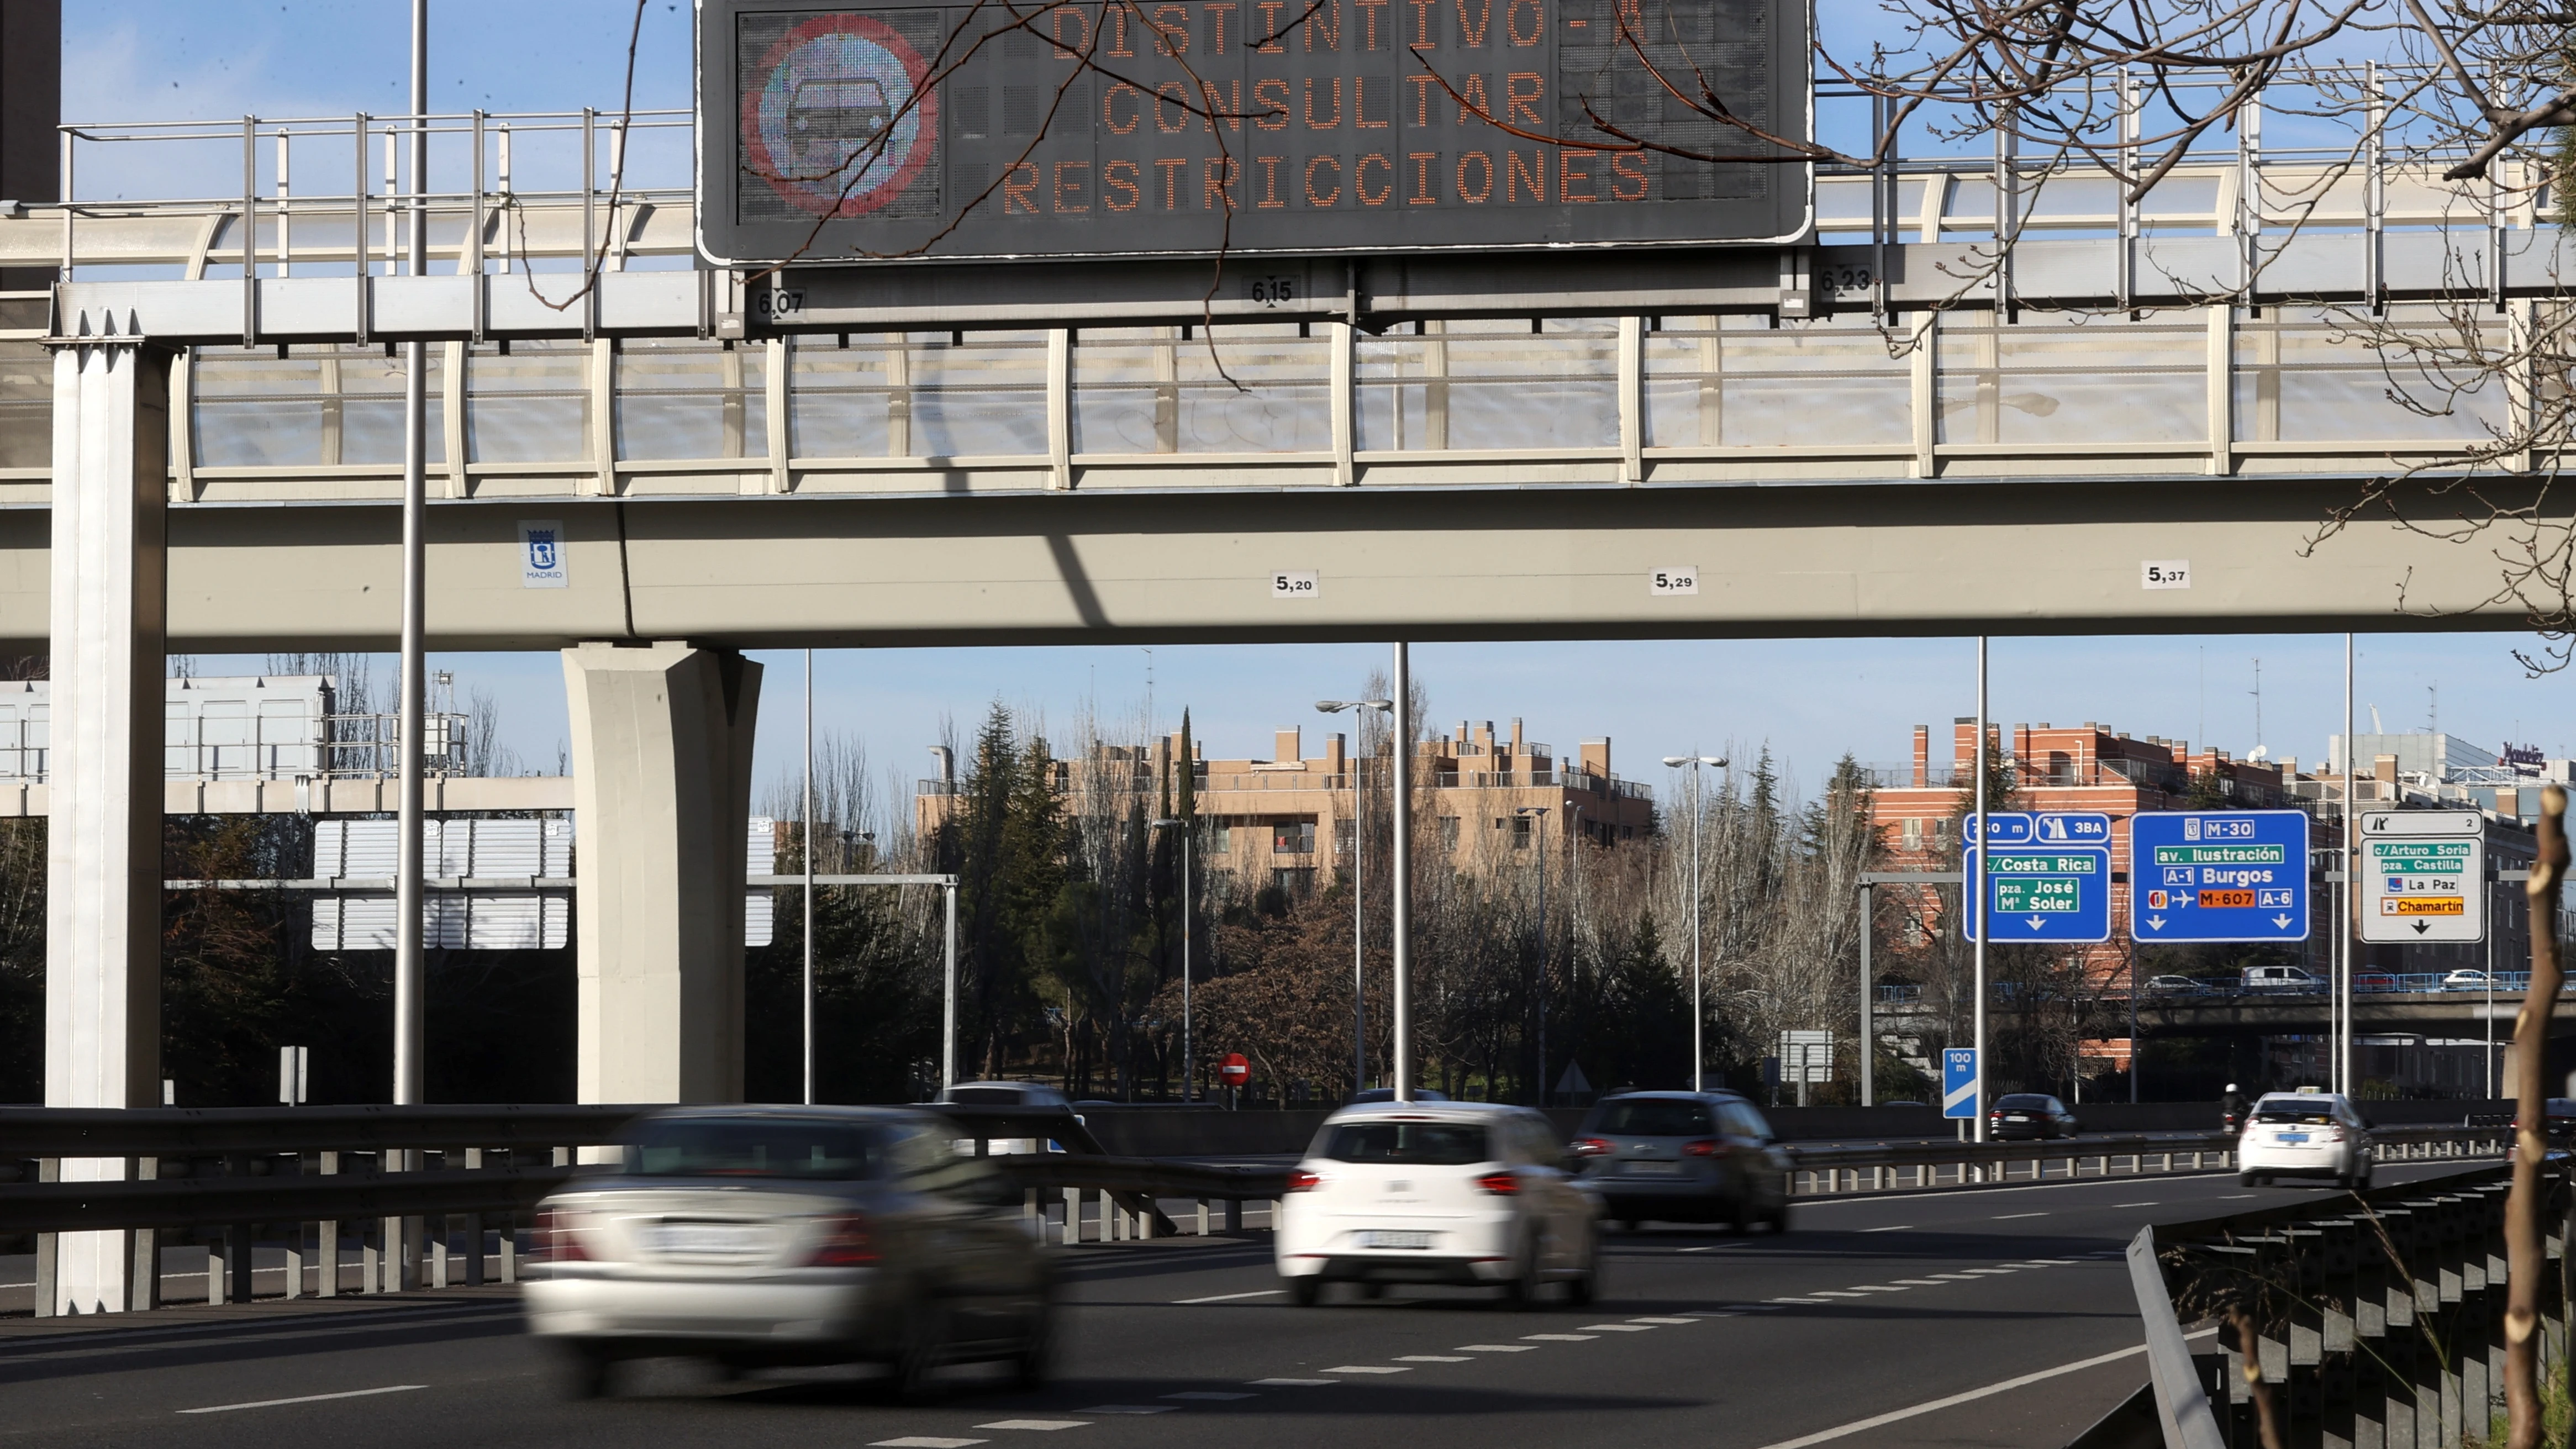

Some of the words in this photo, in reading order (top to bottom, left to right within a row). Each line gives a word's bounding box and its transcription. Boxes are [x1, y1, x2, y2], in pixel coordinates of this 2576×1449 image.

[1105, 72, 1543, 134] CONSULTAR
[1004, 150, 1648, 214] RESTRICCIONES
[1252, 281, 1292, 303] 6,15
[759, 293, 803, 315] 6,07
[1656, 573, 1692, 590] 5,29
[2148, 567, 2185, 584] 5,37
[1276, 576, 1312, 593] 5,20
[2074, 822, 2103, 834] 3BA
[2208, 823, 2251, 836] M-30
[2466, 819, 2473, 827] 2
[2159, 851, 2183, 862] av.
[2193, 846, 2280, 862] Ilustración
[2375, 845, 2429, 855] c/Arturo
[2437, 845, 2469, 855] Soria
[2057, 858, 2092, 871] Rica
[2382, 862, 2407, 872] pza.
[2414, 860, 2462, 870] Castilla
[2167, 869, 2192, 882] A-1
[2203, 867, 2273, 887] Burgos
[1999, 884, 2025, 896] pza.
[2034, 880, 2073, 894] José
[2409, 879, 2425, 890] La
[2433, 879, 2456, 889] Paz
[2029, 896, 2073, 910] Soler
[2200, 893, 2253, 906] M-607
[2262, 892, 2290, 905] A-6
[2398, 900, 2463, 912] Chamartín
[1950, 1053, 1971, 1063] 100
